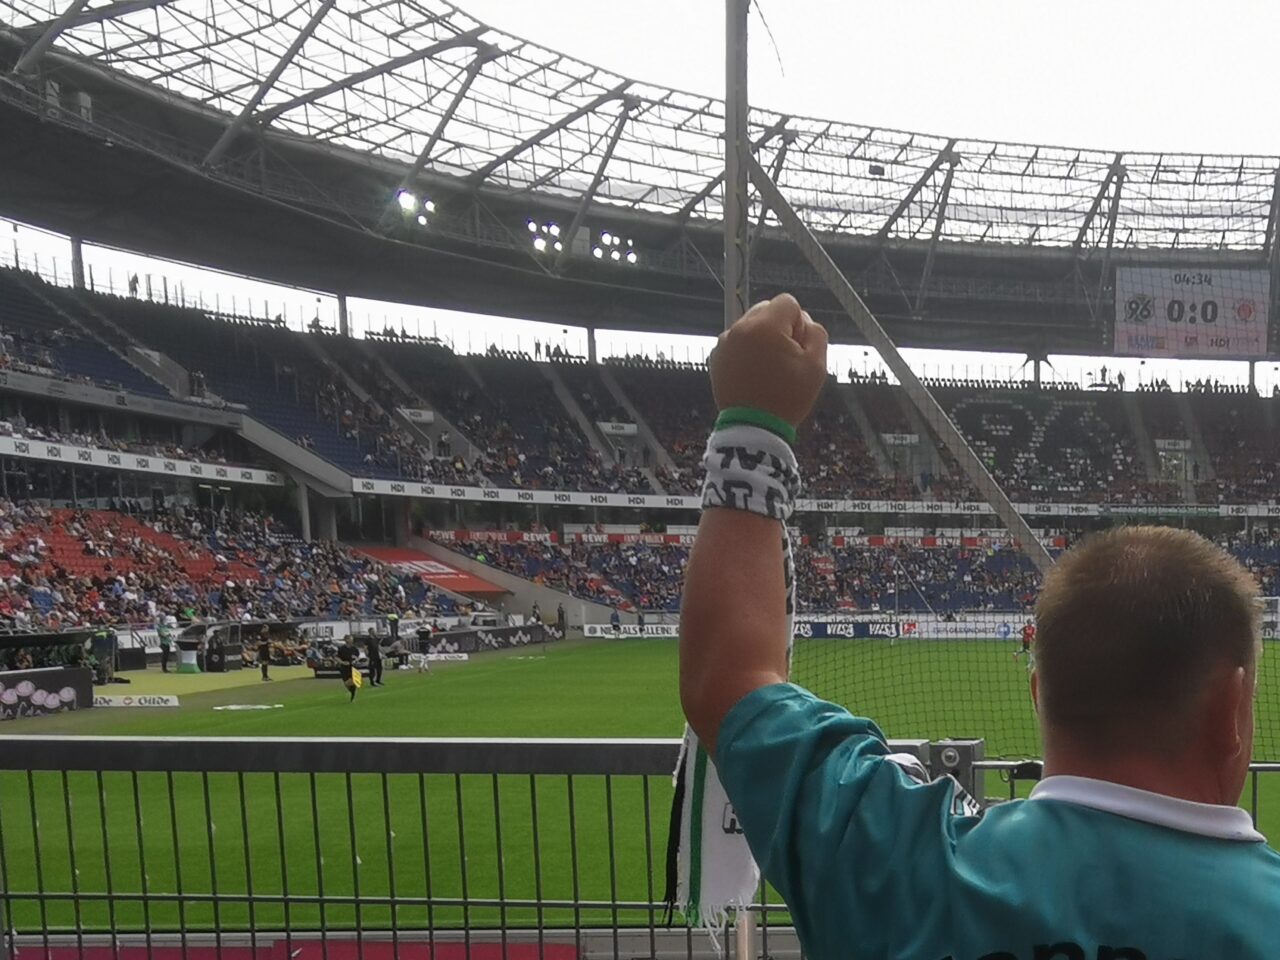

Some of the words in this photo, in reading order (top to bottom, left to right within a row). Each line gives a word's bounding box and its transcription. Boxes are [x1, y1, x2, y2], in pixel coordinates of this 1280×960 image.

[1174, 273, 1212, 286] 04:34
[1167, 300, 1218, 324] 0:0
[361, 480, 375, 491] HDI
[390, 483, 405, 493] HDI
[421, 485, 435, 495] HDI
[450, 487, 466, 497] HDI
[483, 489, 499, 499] HDI
[517, 492, 534, 501] HDI
[554, 494, 571, 502] HDI
[590, 495, 608, 504] HDI
[628, 496, 645, 505] HDI
[666, 497, 684, 506] HDI
[600, 625, 638, 635] NIEALS
